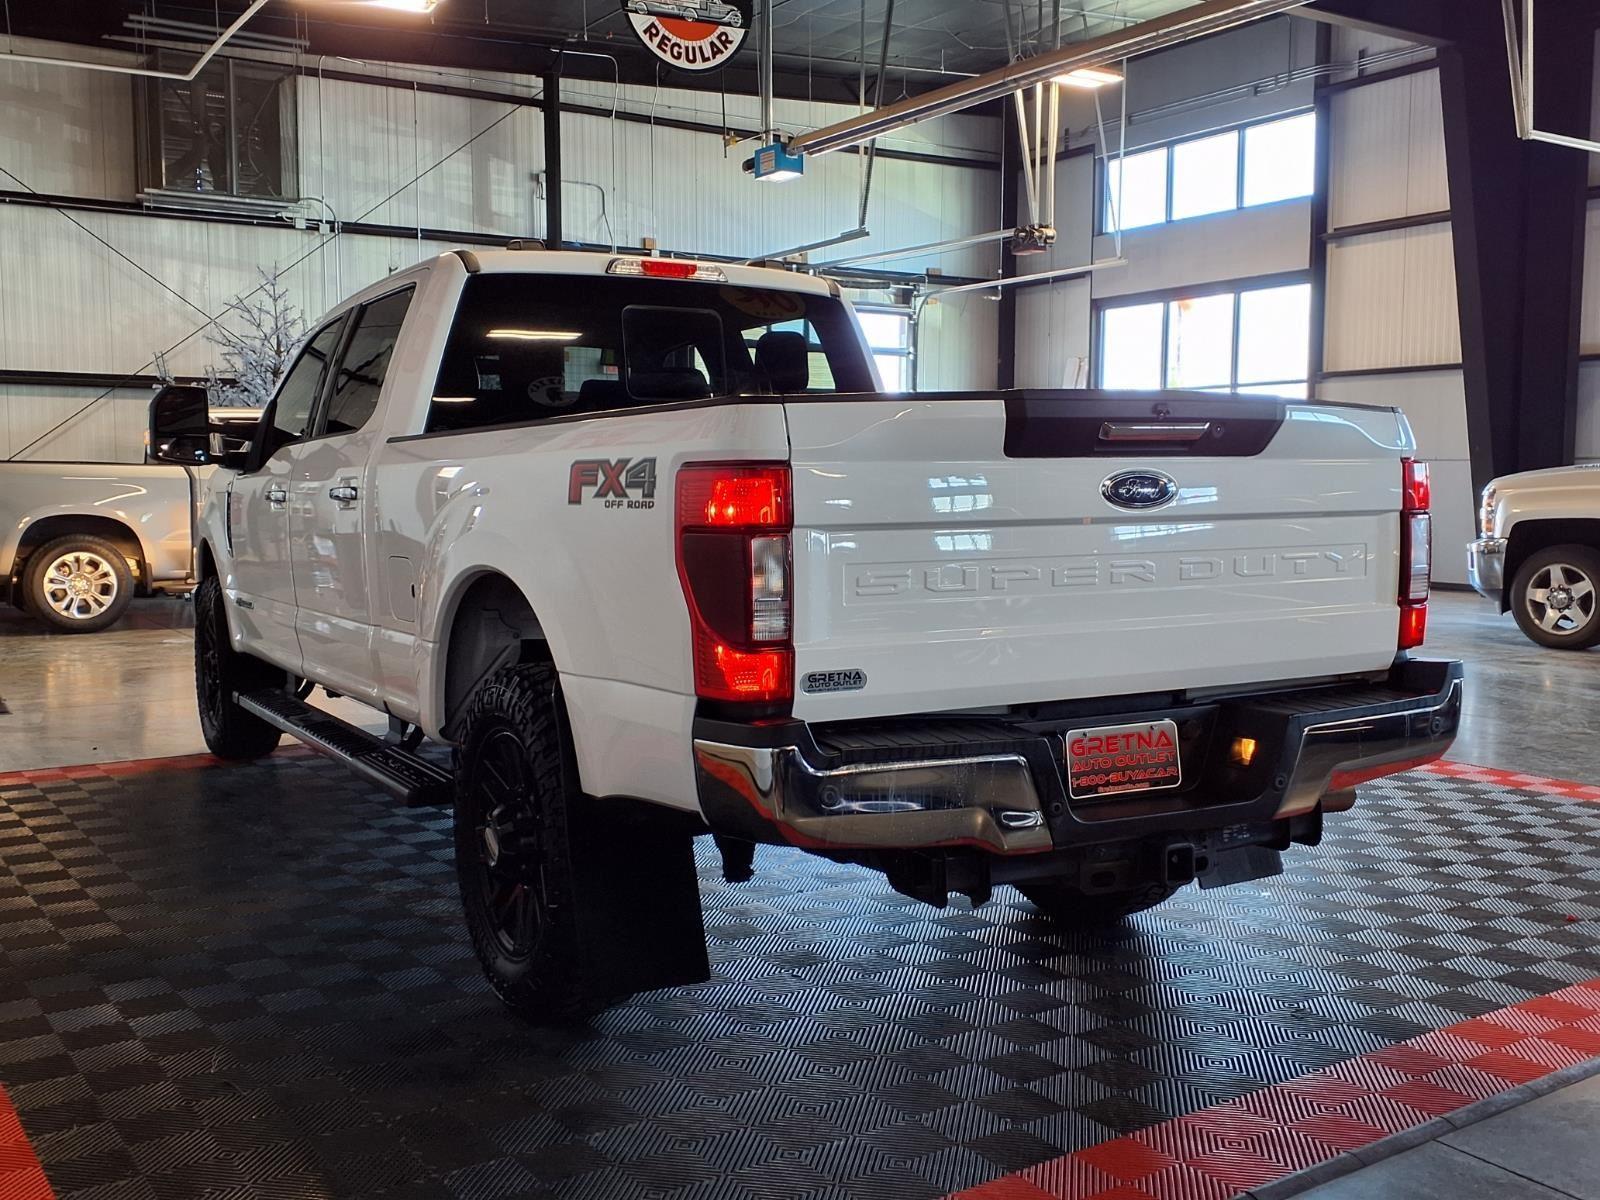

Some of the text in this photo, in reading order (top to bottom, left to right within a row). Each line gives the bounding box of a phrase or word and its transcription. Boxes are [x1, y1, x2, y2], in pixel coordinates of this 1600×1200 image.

[643, 21, 734, 64] REGULAR
[568, 456, 657, 505] FX4
[604, 500, 655, 509] OFF ROAD
[855, 551, 1361, 597] SUPER DUTY
[807, 671, 862, 683] GRETNA
[1071, 730, 1174, 757] GRETNA
[1071, 750, 1176, 772] AUTO OUTLET
[1071, 766, 1178, 788] 1-800-BUYACAR
